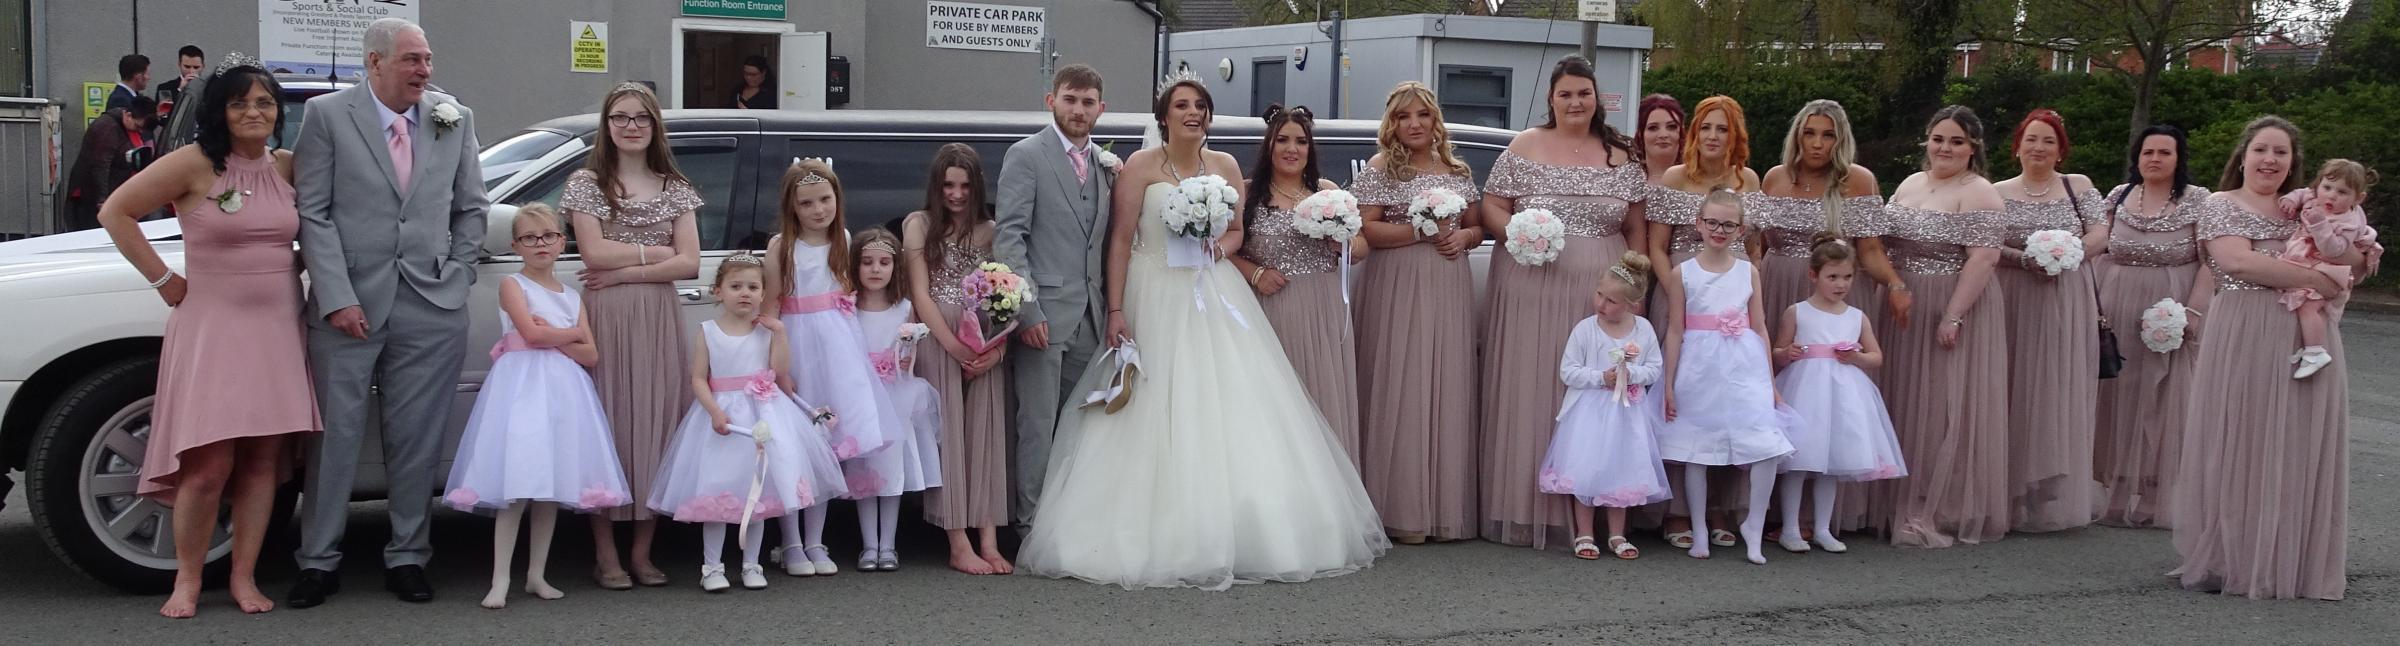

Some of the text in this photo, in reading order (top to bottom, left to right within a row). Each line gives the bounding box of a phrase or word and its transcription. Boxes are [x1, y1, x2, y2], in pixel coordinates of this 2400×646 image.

[292, 2, 323, 12] Sports
[326, 3, 334, 12] &
[337, 4, 364, 14] Social
[367, 6, 388, 15] Club
[684, 0, 784, 11] Function Room Entrance
[930, 5, 1043, 22] PRIVATE CAR PARK
[306, 18, 351, 28] MEMBERS
[933, 20, 1038, 35] FOR USE BY MEMBERS
[942, 35, 1031, 48] AND GUESTS ONLY
